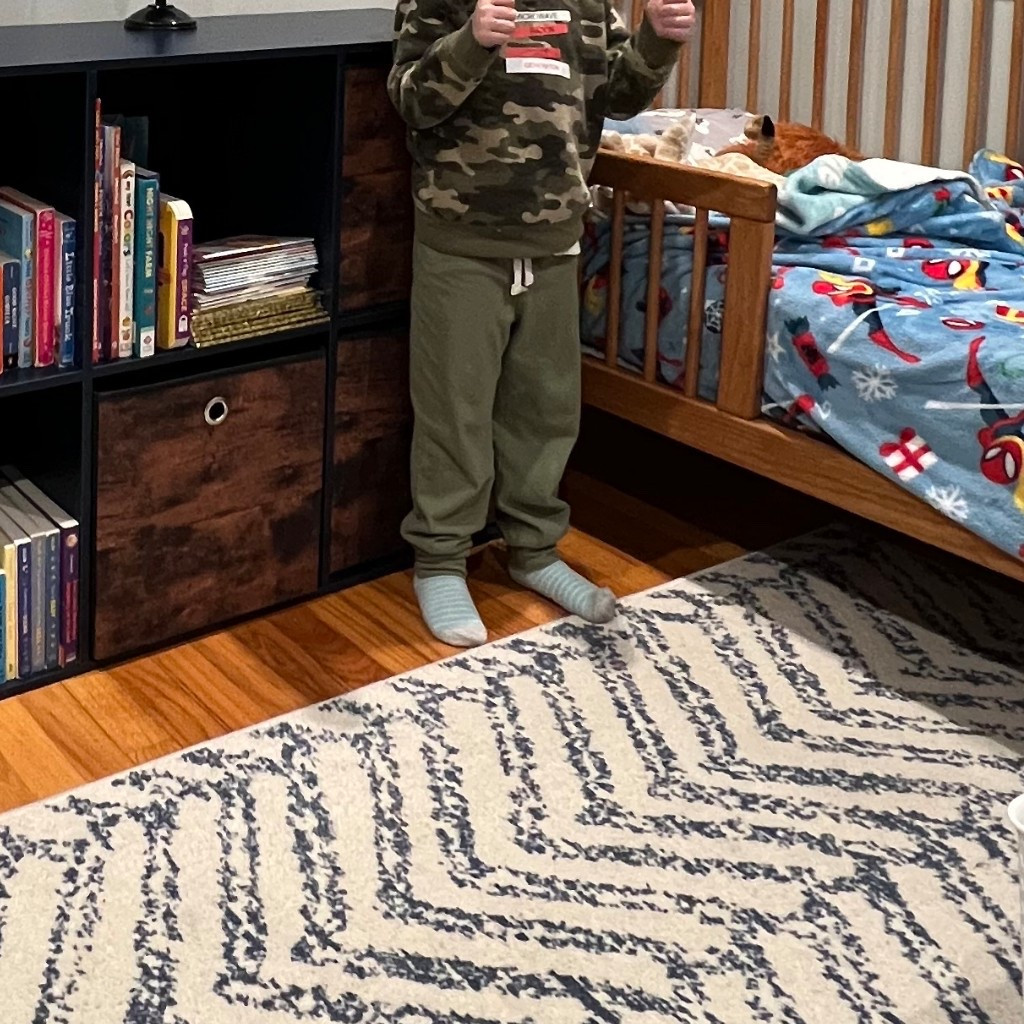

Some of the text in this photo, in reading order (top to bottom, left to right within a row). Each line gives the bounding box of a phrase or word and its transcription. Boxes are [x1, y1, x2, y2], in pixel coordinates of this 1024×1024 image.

[145, 251, 154, 278] FARM
[65, 285, 74, 306] Blue
[64, 307, 74, 341] Truck
